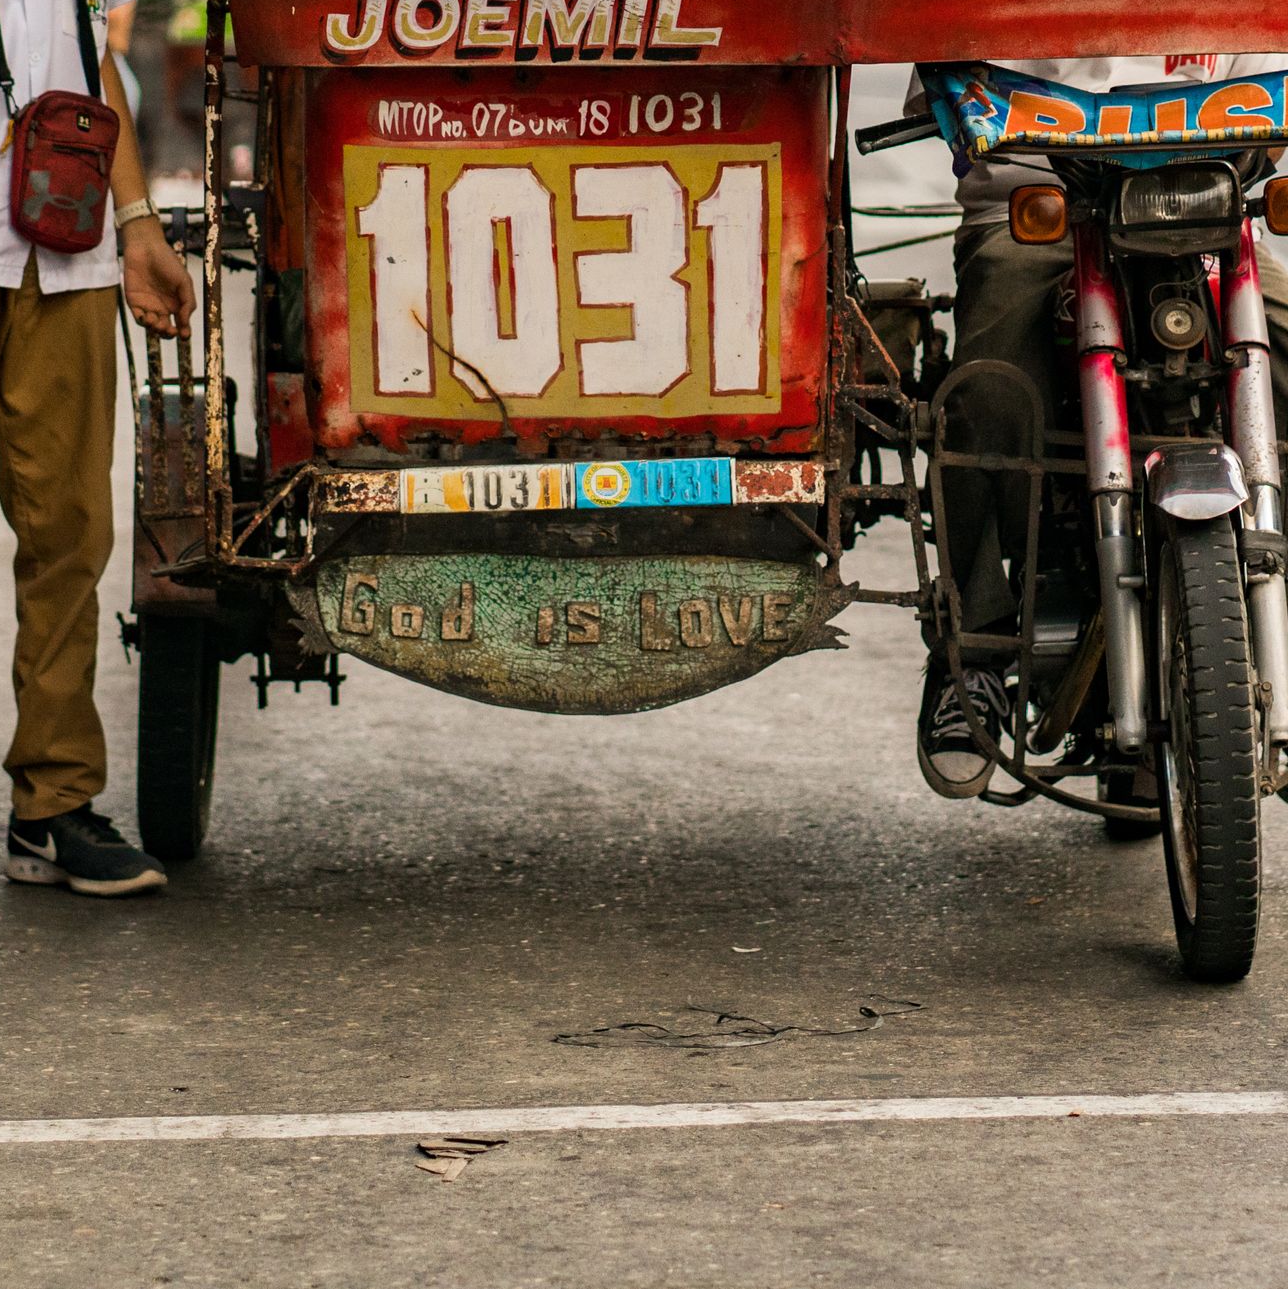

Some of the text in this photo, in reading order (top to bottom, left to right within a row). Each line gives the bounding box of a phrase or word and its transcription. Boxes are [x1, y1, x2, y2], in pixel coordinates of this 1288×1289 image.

[378, 100, 443, 137] MTOP
[578, 99, 611, 136] 18
[629, 91, 721, 134] 1031
[355, 159, 769, 401] 1031
[462, 467, 551, 511] 1031
[635, 460, 720, 504] 1031
[338, 573, 476, 641] God
